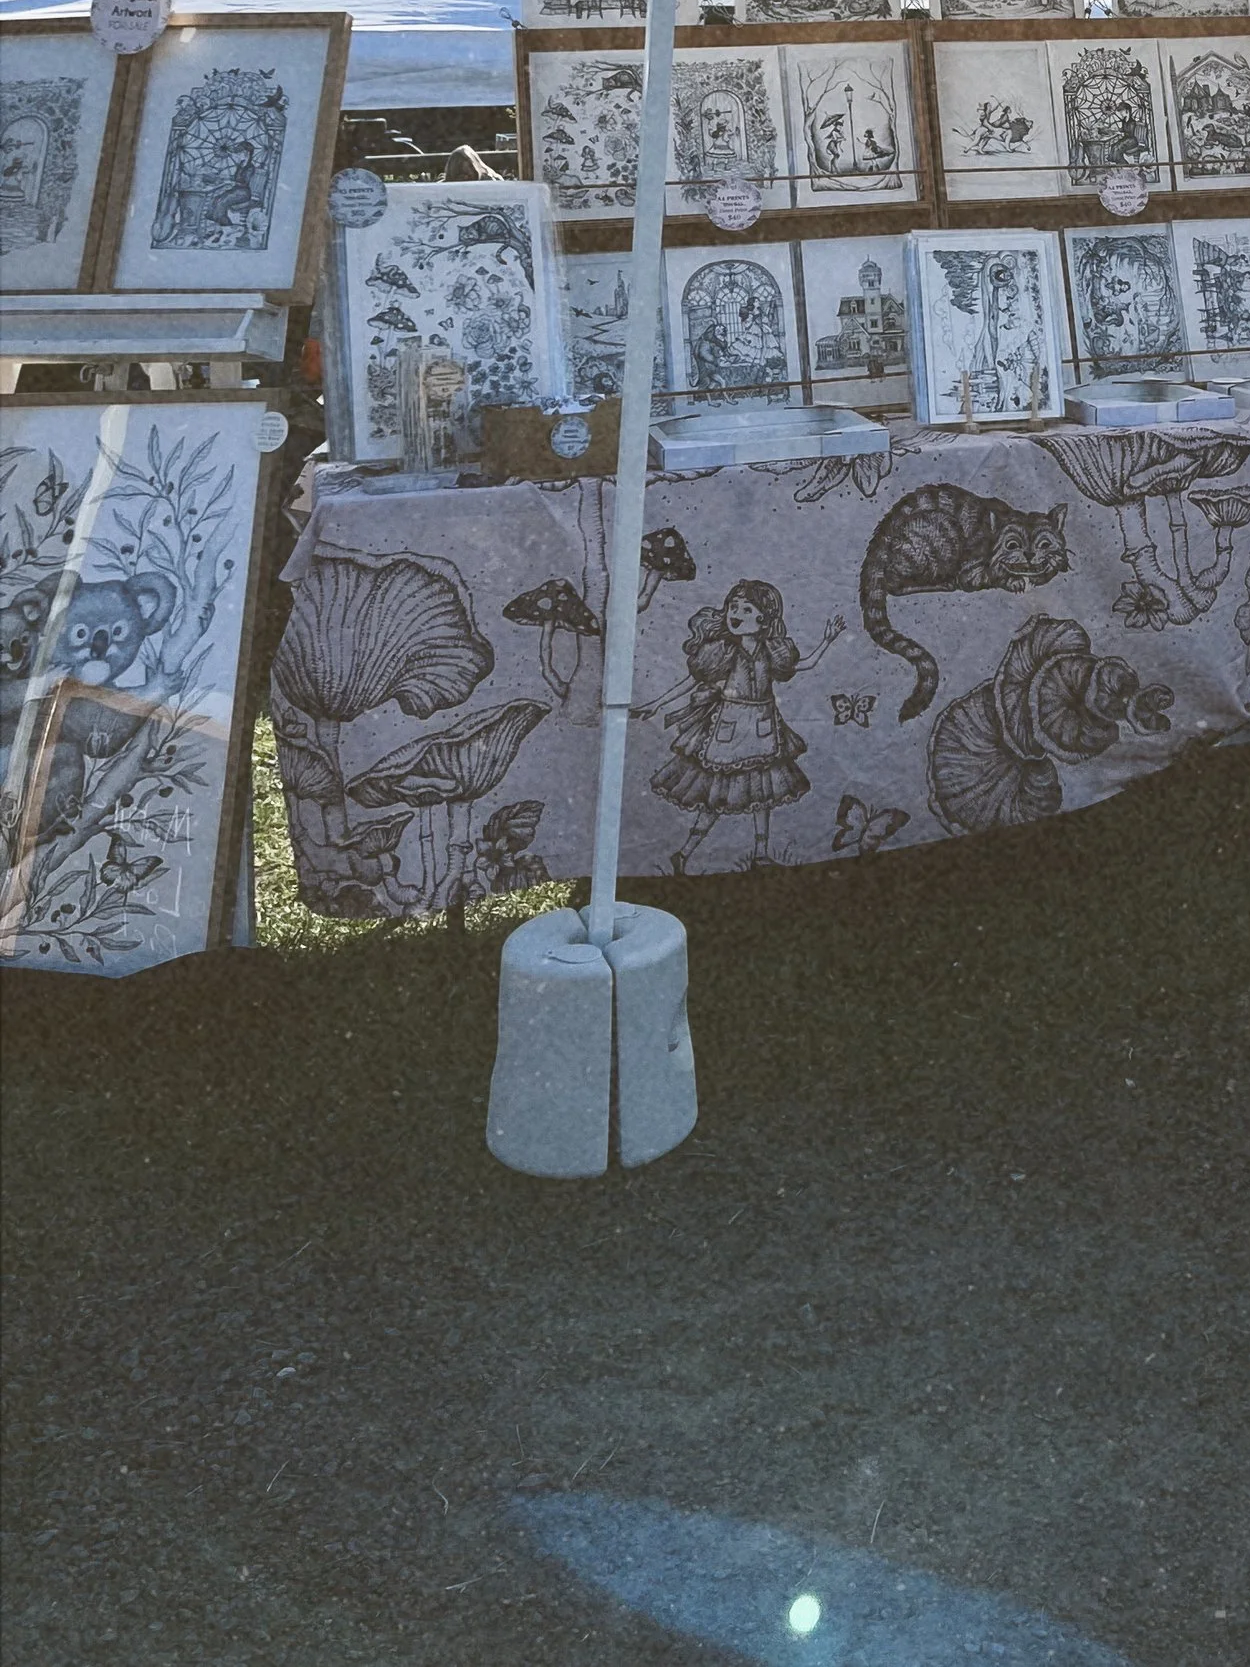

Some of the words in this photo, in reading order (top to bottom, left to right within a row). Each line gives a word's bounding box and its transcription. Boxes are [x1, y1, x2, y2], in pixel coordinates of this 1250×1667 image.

[111, 5, 153, 18] Artwork
[108, 20, 127, 30] FOR
[129, 21, 149, 31] SALE
